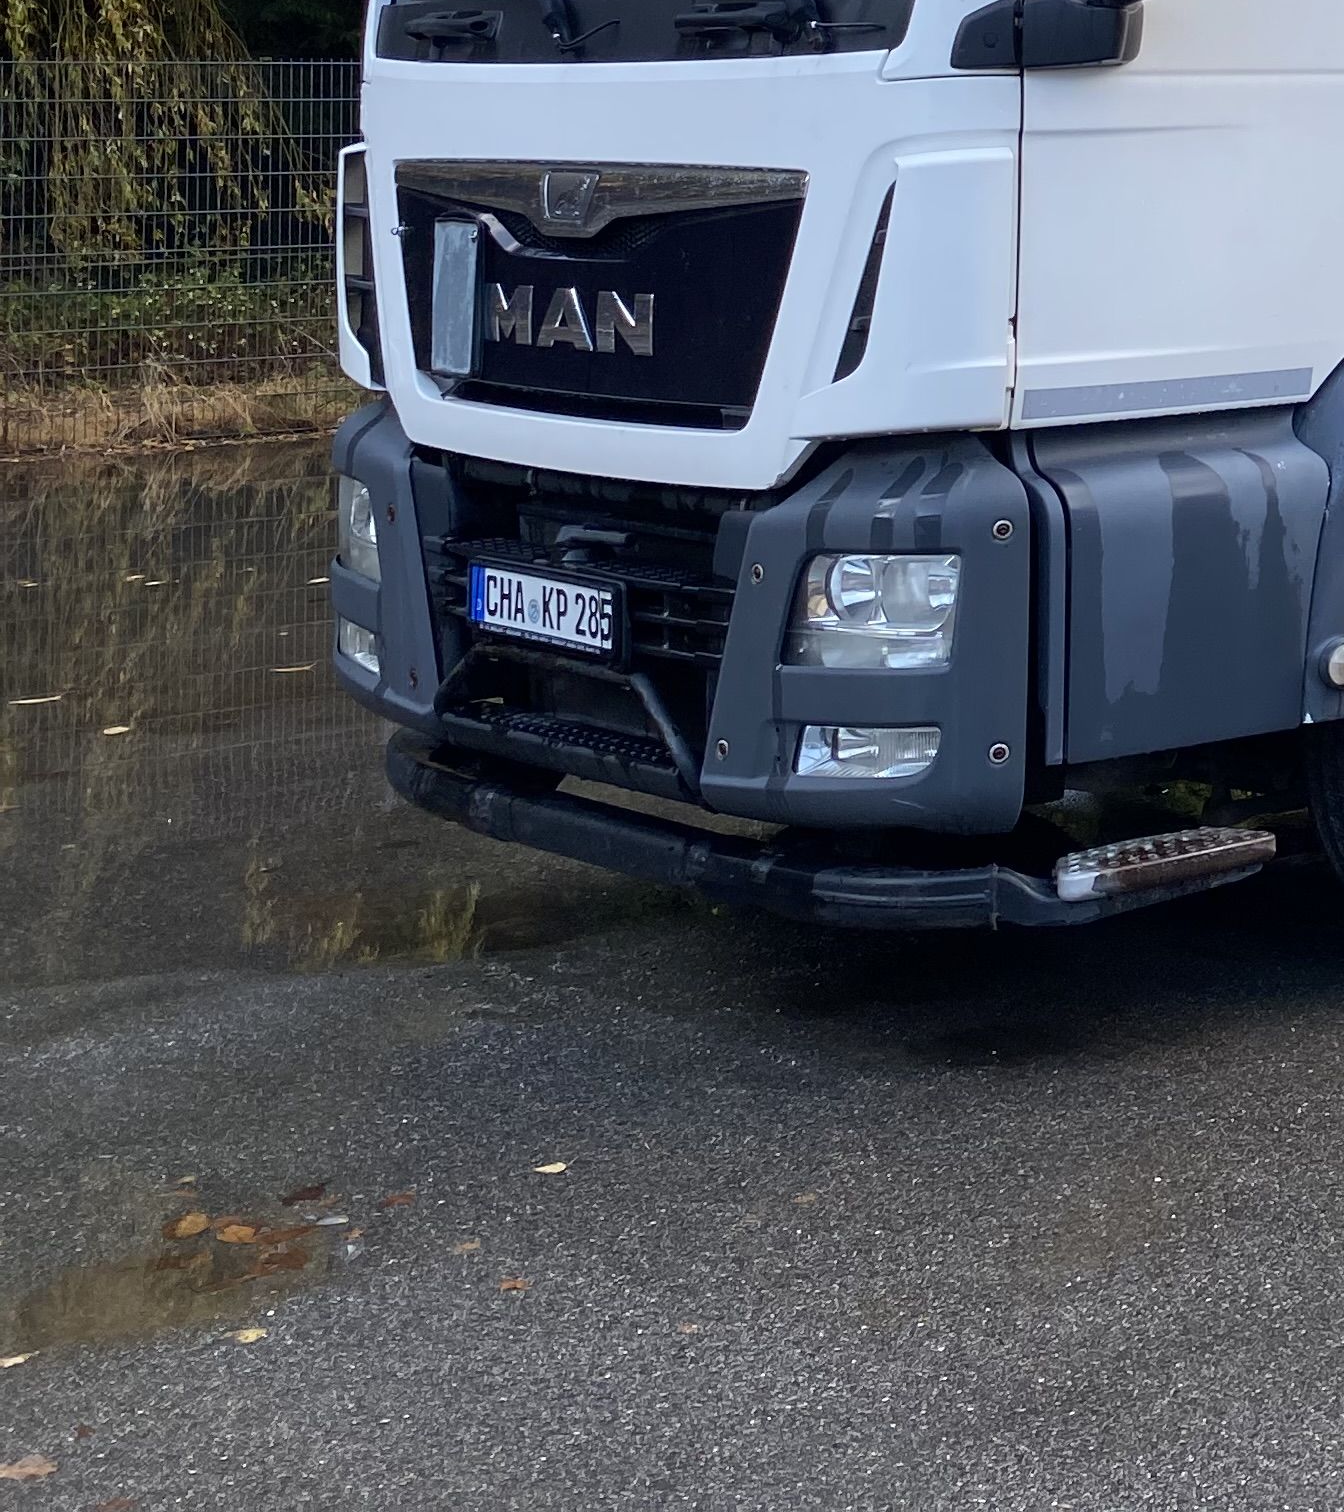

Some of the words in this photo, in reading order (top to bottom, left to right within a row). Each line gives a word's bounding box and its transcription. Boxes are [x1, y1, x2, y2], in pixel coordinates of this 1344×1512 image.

[486, 282, 654, 357] MAN
[486, 574, 526, 624] CHA
[542, 585, 568, 631] KP
[575, 591, 613, 642] 285
